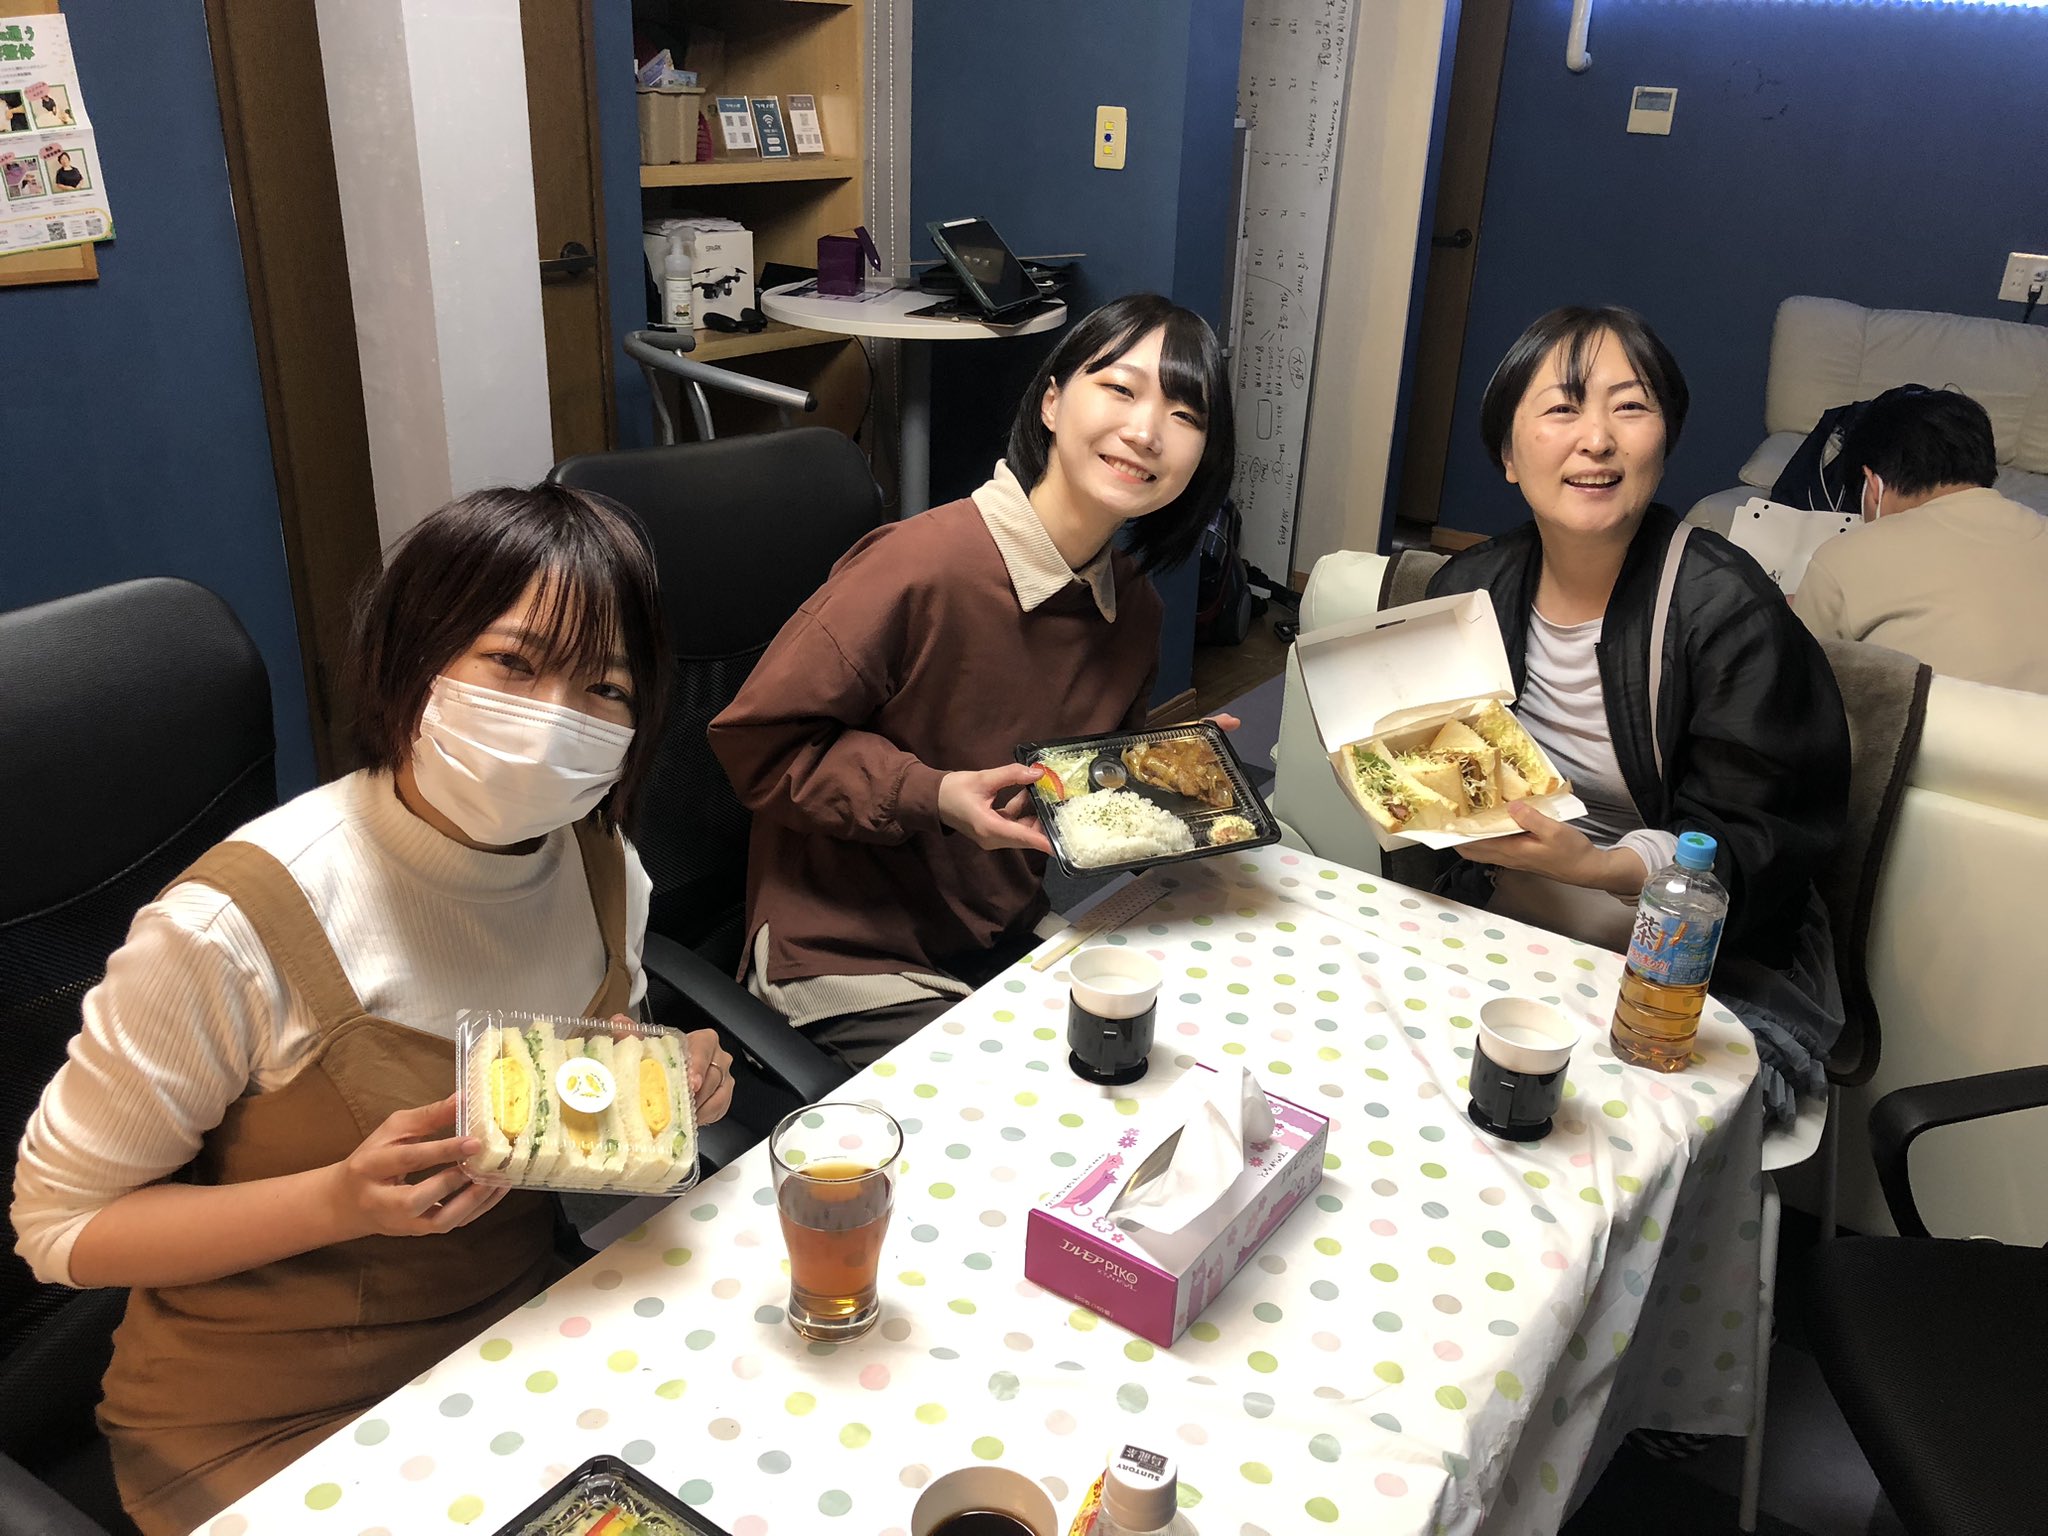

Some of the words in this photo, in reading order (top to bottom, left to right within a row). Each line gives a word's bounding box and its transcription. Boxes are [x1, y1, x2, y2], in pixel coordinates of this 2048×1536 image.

[1634, 911, 1661, 951] 茶
[1058, 1238, 1105, 1265] エルモア
[1104, 1260, 1139, 1285] PIKO
[1116, 1463, 1160, 1482] SUNTORY
